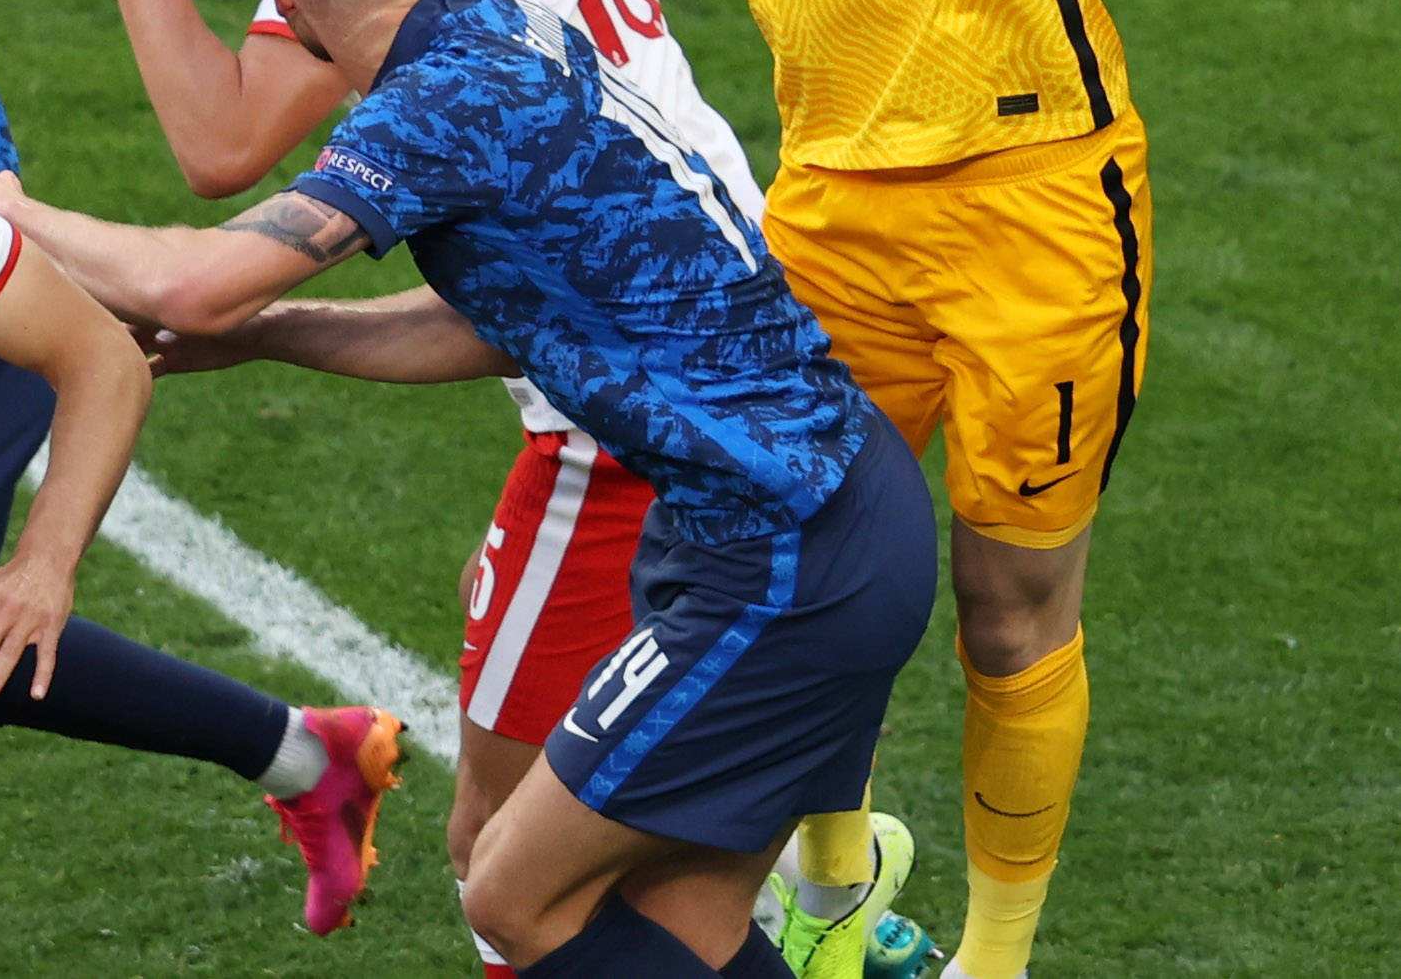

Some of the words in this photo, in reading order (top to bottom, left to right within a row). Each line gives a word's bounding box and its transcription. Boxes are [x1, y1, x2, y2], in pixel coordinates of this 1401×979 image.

[327, 152, 393, 192] RESPECT
[1053, 380, 1074, 465] 1
[587, 626, 670, 732] 14
